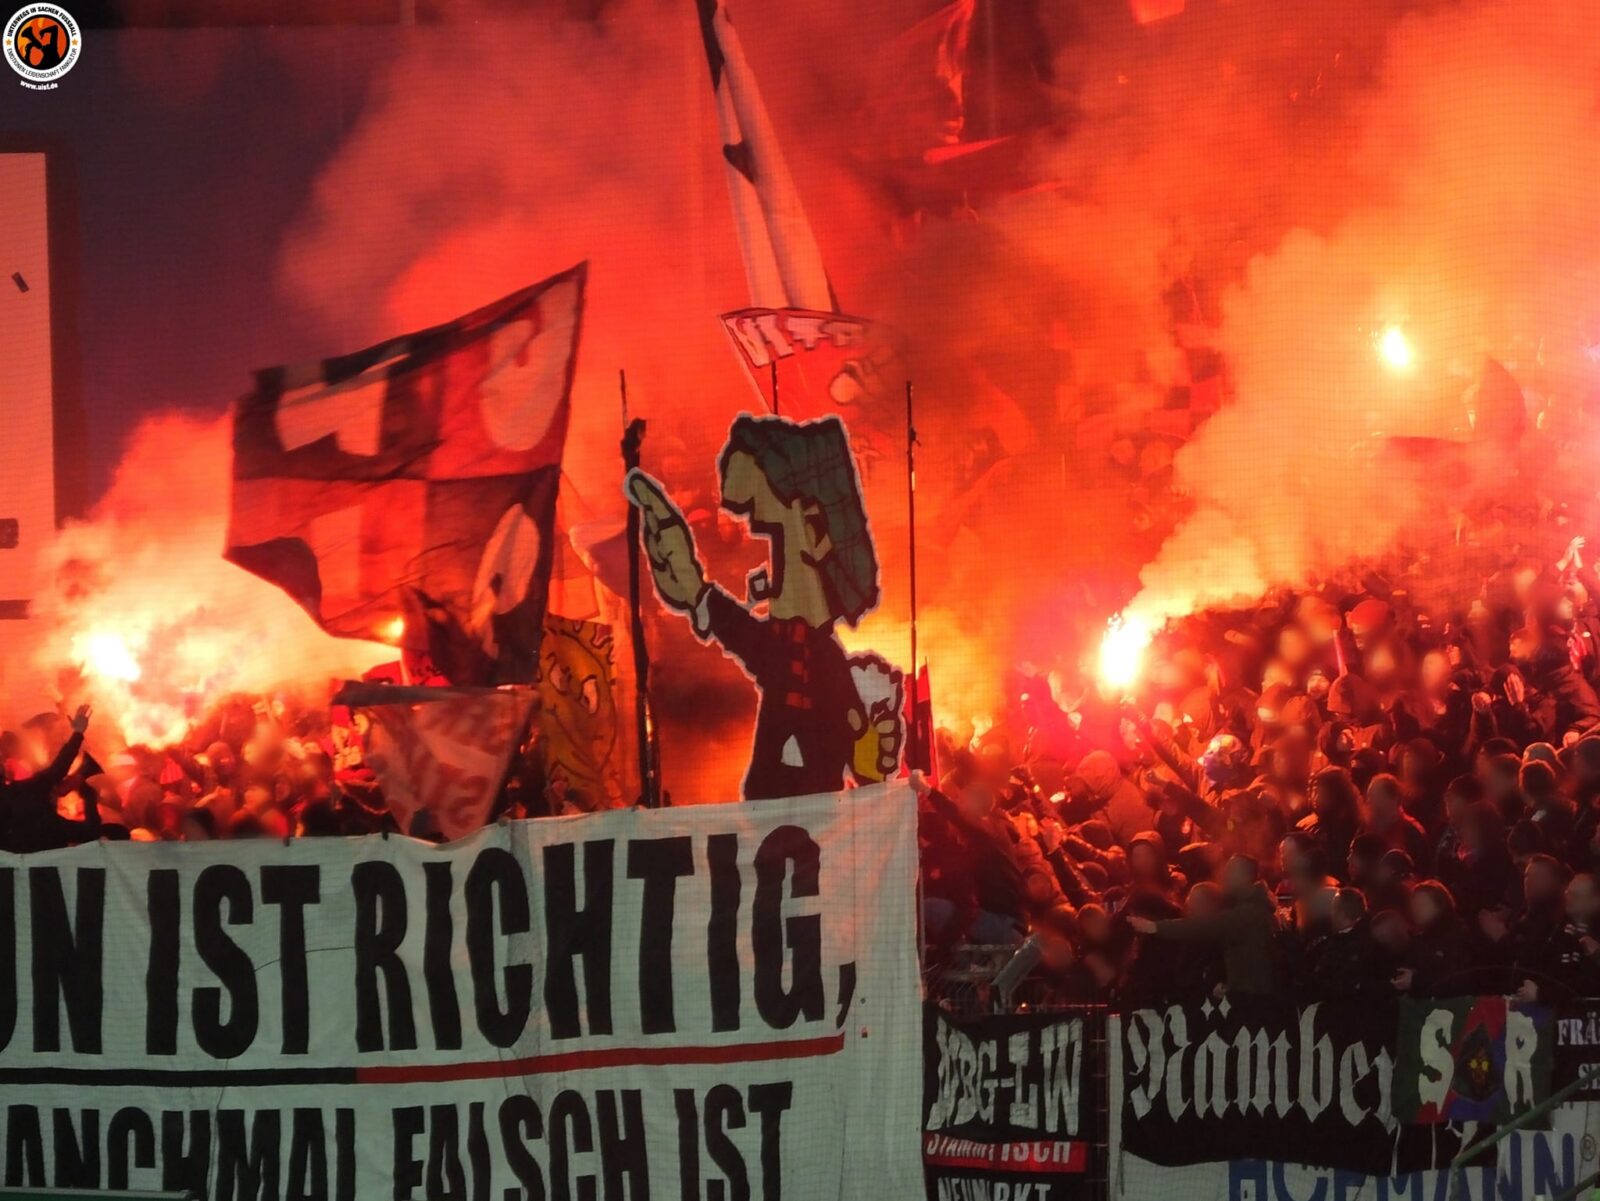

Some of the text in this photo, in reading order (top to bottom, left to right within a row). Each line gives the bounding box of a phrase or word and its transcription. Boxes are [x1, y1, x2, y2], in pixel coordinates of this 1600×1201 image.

[146, 863, 320, 1060] IST
[352, 825, 857, 1053] RICHTIG,
[1557, 1011, 1600, 1046] FRÄ
[673, 1081, 793, 1201] IST
